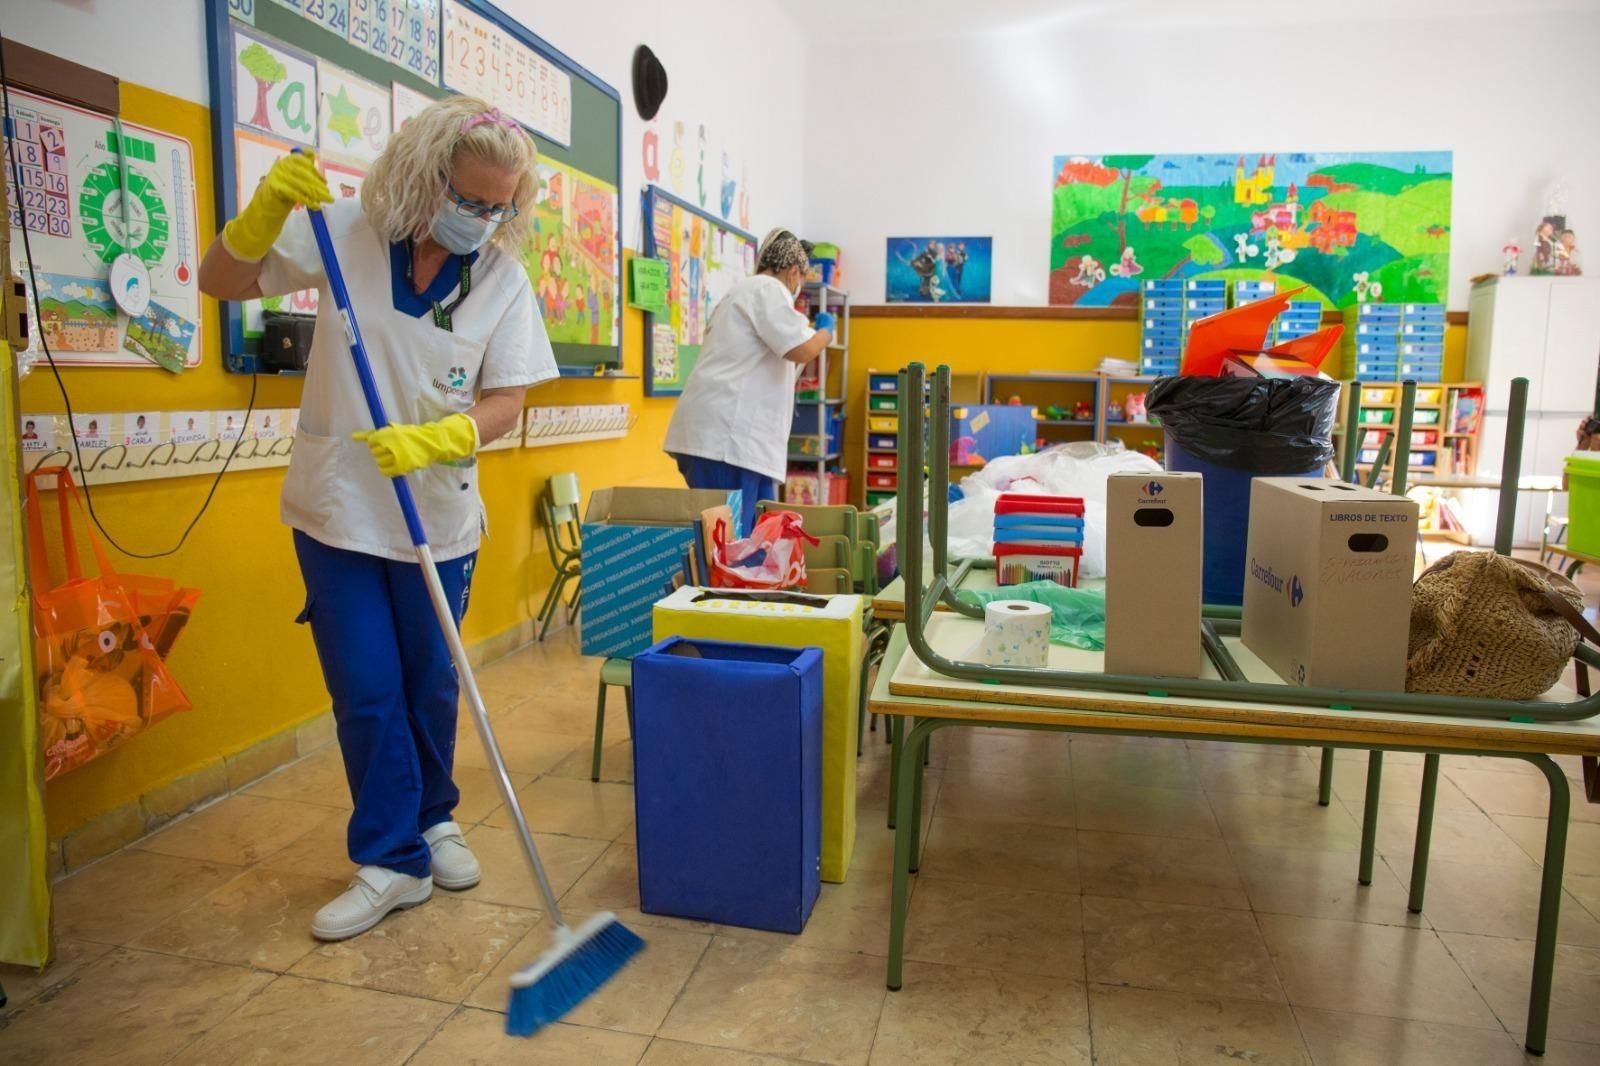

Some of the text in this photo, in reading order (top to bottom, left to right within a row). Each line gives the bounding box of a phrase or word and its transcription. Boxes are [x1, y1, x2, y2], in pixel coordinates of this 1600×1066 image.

[328, 3, 346, 32] 24
[392, 7, 404, 31] 17
[410, 18, 421, 42] 18
[427, 28, 437, 50] 19
[352, 16, 438, 80] 25 26 27 28 29
[447, 30, 454, 60] 1
[460, 37, 470, 69] 2
[476, 46, 486, 77] 3
[492, 53, 500, 84] 4
[505, 62, 513, 92] 5
[516, 71, 525, 98] 6
[528, 76, 536, 104] 7
[541, 86, 548, 112] 8
[26, 123, 60, 148] 1 2
[27, 145, 37, 162] 8
[53, 155, 61, 170] 9
[26, 169, 44, 187] 15
[49, 174, 65, 192] 16
[25, 190, 44, 209] 22
[48, 197, 67, 216] 23
[27, 212, 47, 230] 29
[51, 217, 70, 235] 30
[1137, 497, 1167, 505] Carrefour
[1330, 514, 1408, 522] LIBROS DE TEXTO
[1251, 558, 1284, 593] Carrefour
